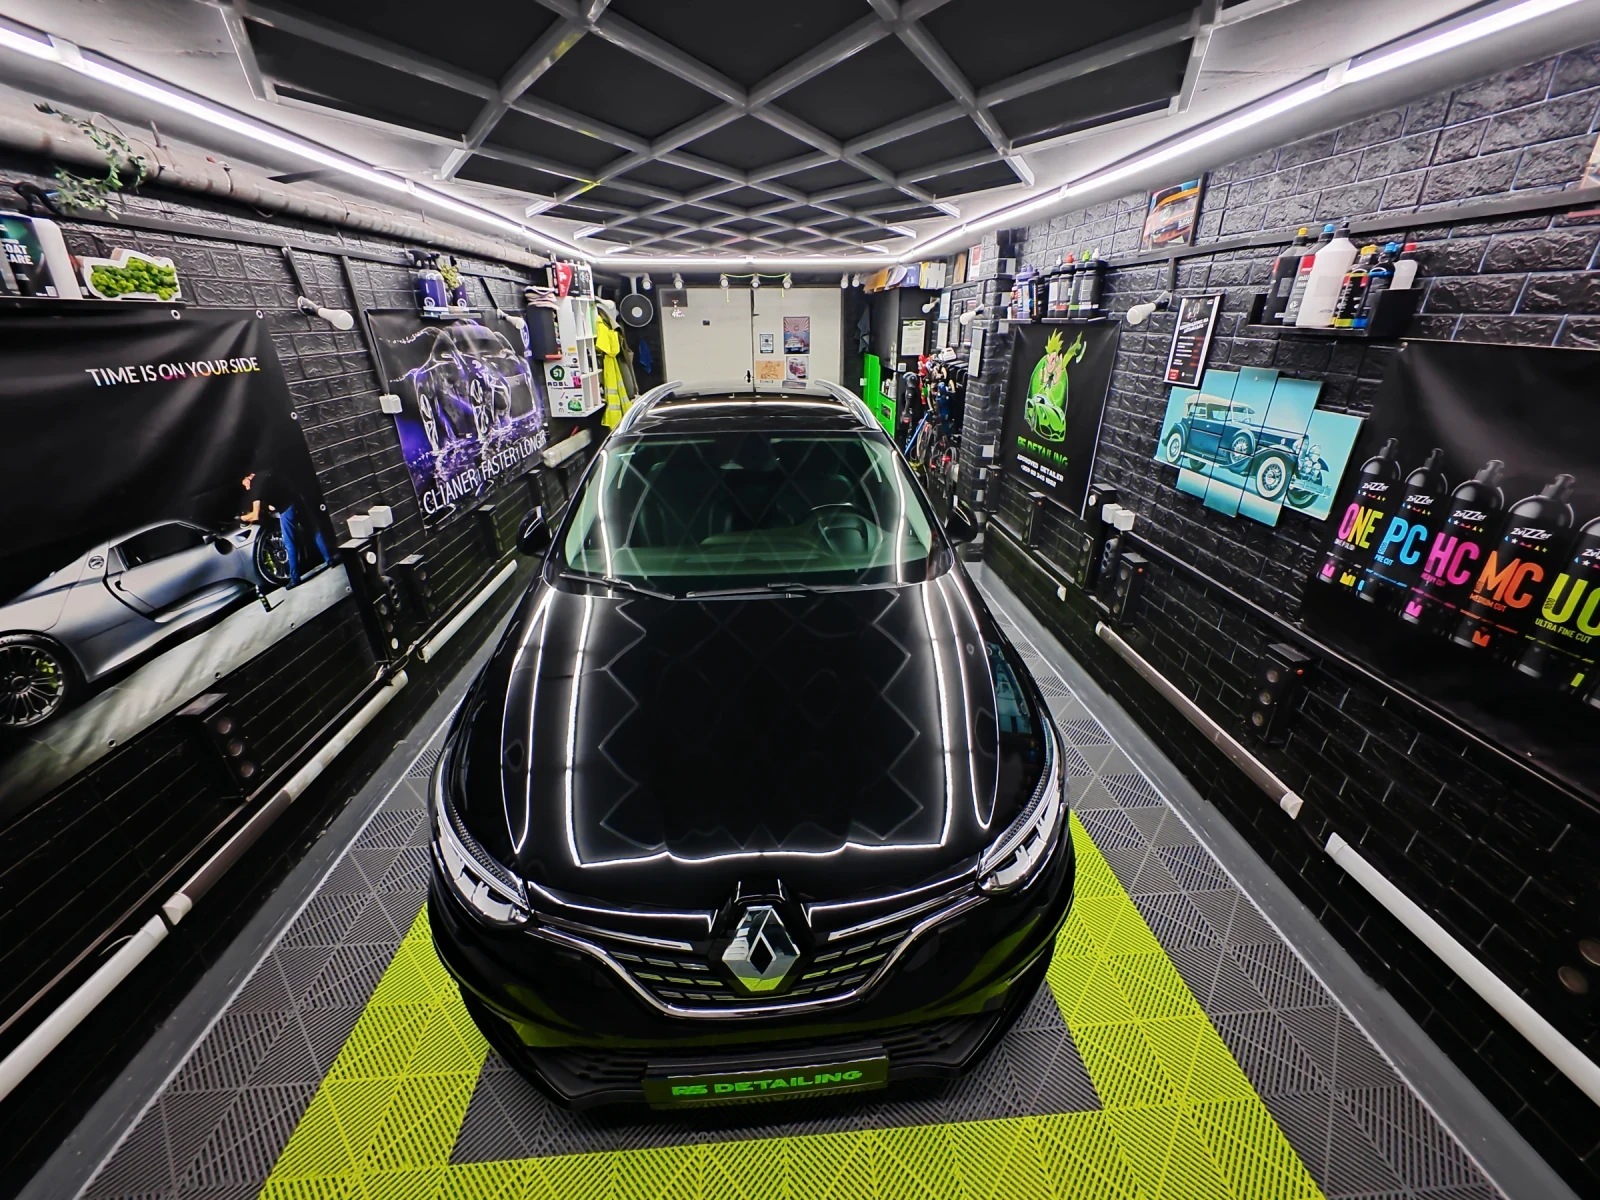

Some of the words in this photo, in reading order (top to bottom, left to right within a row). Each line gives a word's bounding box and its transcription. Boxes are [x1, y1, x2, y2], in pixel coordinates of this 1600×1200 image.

[3, 243, 27, 255] OAT
[7, 254, 34, 265] ARE
[85, 366, 140, 387] TIME
[140, 365, 157, 382] IS
[158, 363, 187, 381] ON
[185, 359, 230, 378] YOUR
[230, 357, 260, 374] SIDE
[481, 446, 517, 480] FASTER
[1338, 502, 1384, 549] ONE
[1378, 516, 1428, 565] PC
[1424, 532, 1480, 585] HC
[1474, 550, 1544, 609] MC
[1493, 602, 1507, 612] CUT
[1535, 617, 1557, 633] ULTRA
[1557, 625, 1574, 639] FINE
[1575, 632, 1593, 644] CUT
[671, 1084, 708, 1096] RS
[714, 1070, 863, 1094] DETAILING
